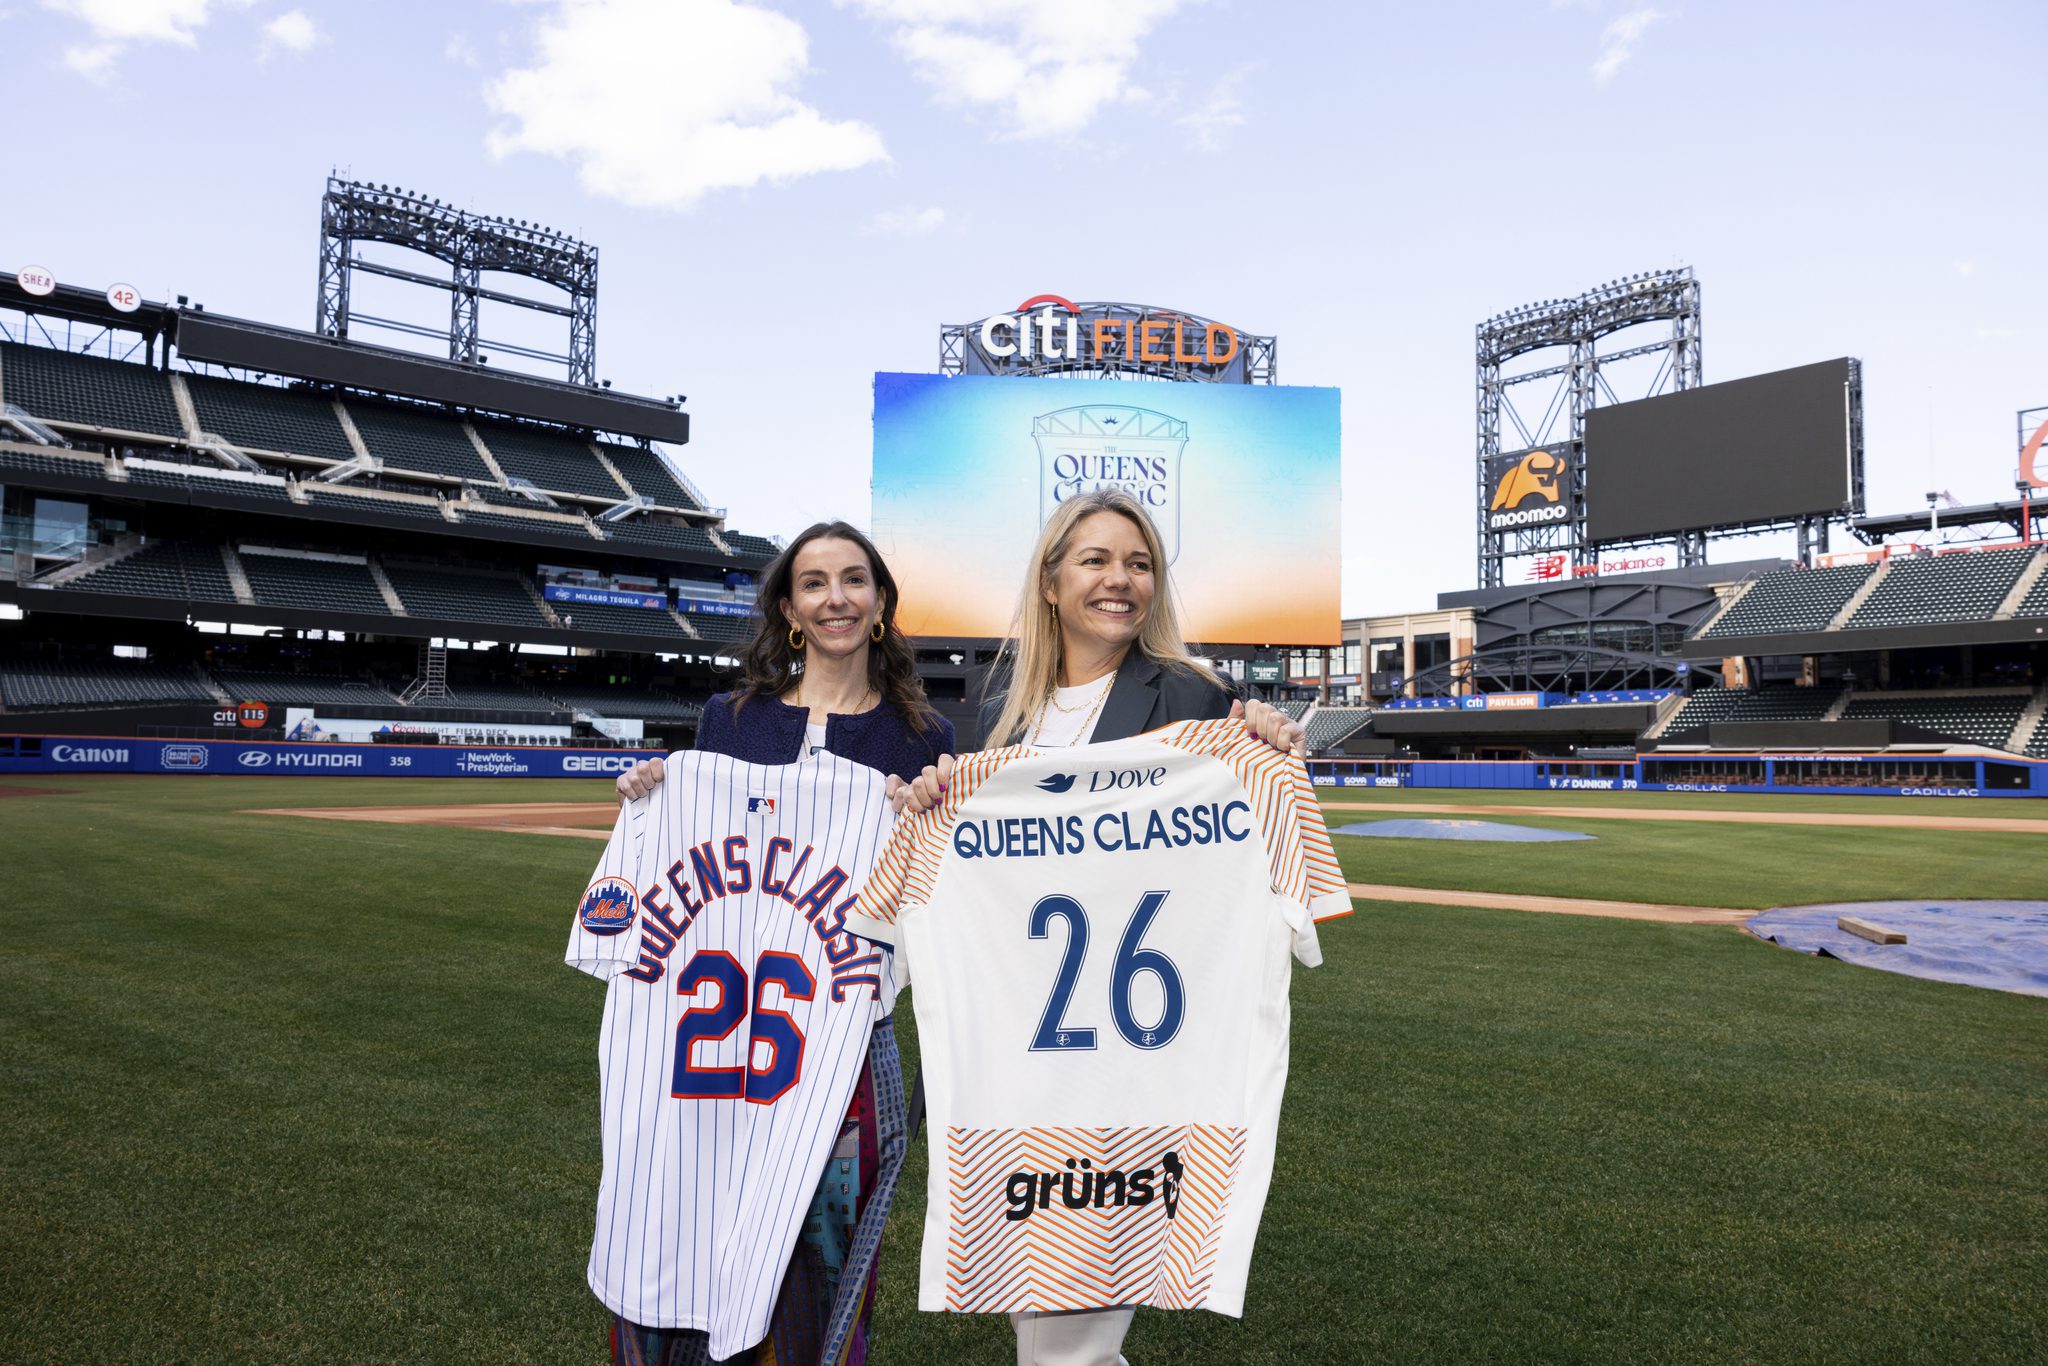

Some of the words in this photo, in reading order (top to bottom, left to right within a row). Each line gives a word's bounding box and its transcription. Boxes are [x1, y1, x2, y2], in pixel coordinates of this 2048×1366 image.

[23, 273, 51, 288] SHEA
[113, 291, 134, 305] 42
[981, 305, 1077, 360] citi
[1094, 319, 1239, 365] FIELD
[1104, 446, 1118, 456] THE
[1053, 454, 1167, 486] QUEENS
[1491, 505, 1567, 528] moomoo
[1603, 556, 1665, 573] balance
[575, 593, 608, 602] MILAGRO
[610, 596, 639, 605] TEQUILA
[1466, 697, 1483, 708] citi
[1489, 697, 1534, 707] PAVILION
[213, 709, 236, 722] citi
[244, 709, 265, 720] 115
[392, 723, 422, 734] Coors
[52, 745, 129, 763] Canon
[276, 753, 362, 767] HYUNDAI
[390, 757, 412, 766] 358
[563, 757, 638, 772] GEICO
[467, 763, 529, 775] Presbyterian
[1088, 767, 1167, 793] Dove
[1313, 776, 1336, 785] GOYA
[1344, 776, 1367, 785] GOYA
[1375, 777, 1399, 786] GOYA
[1571, 779, 1613, 789] DUNKIN'
[1622, 779, 1637, 789] 370
[1666, 784, 1727, 792] CADILLAC
[1901, 788, 1980, 797] CADILLAC
[954, 816, 1084, 859] QUEENS
[1094, 800, 1251, 852] CLASSIC
[587, 898, 629, 919] Mets
[623, 836, 752, 984] QUEENS
[1028, 890, 1186, 1052] 26
[671, 949, 818, 1106] 26
[1006, 1157, 1155, 1222] grüns
